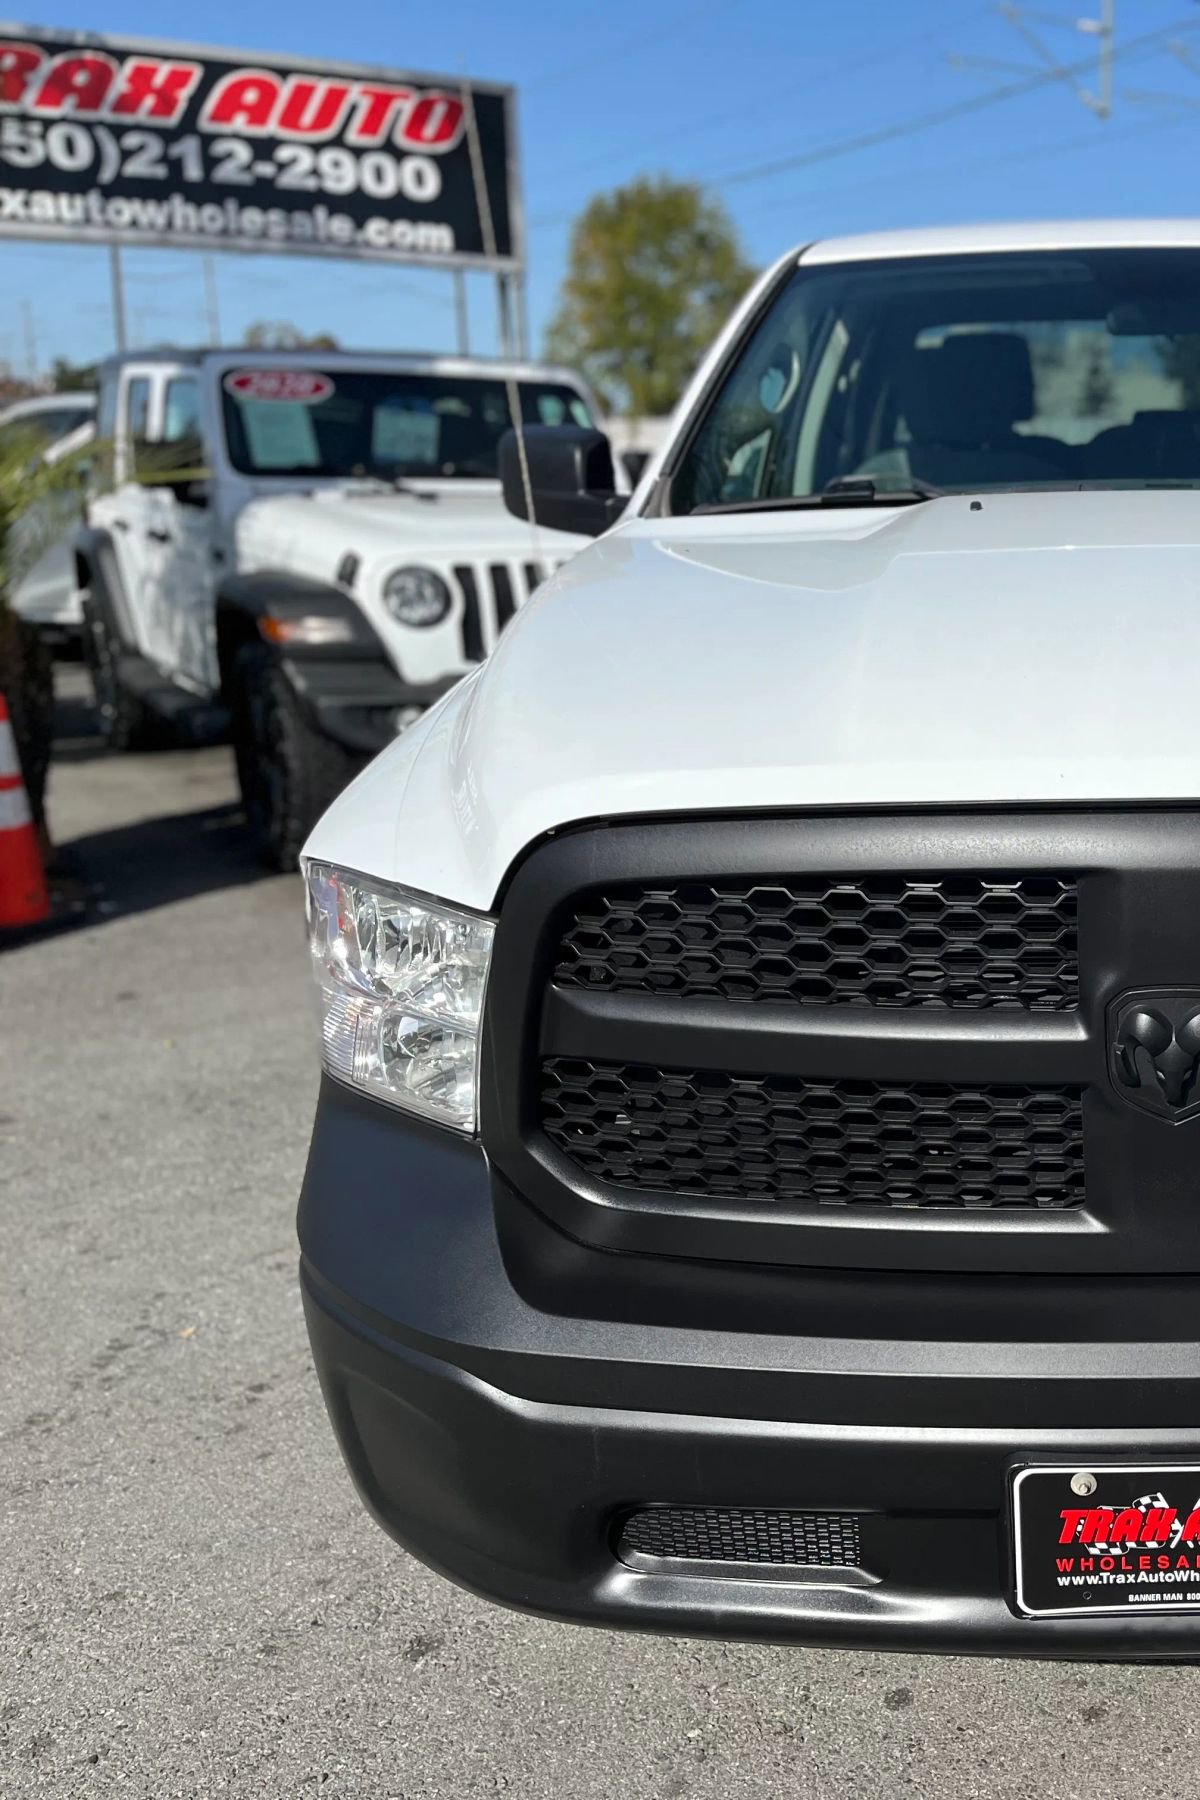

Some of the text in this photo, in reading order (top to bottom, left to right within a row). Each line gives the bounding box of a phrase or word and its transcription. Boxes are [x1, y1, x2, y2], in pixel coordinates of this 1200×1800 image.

[201, 69, 466, 153] AUTO
[1058, 1508, 1178, 1543] TRAX
[1128, 1593, 1162, 1602] BANNER
[1163, 1593, 1183, 1601] MAN
